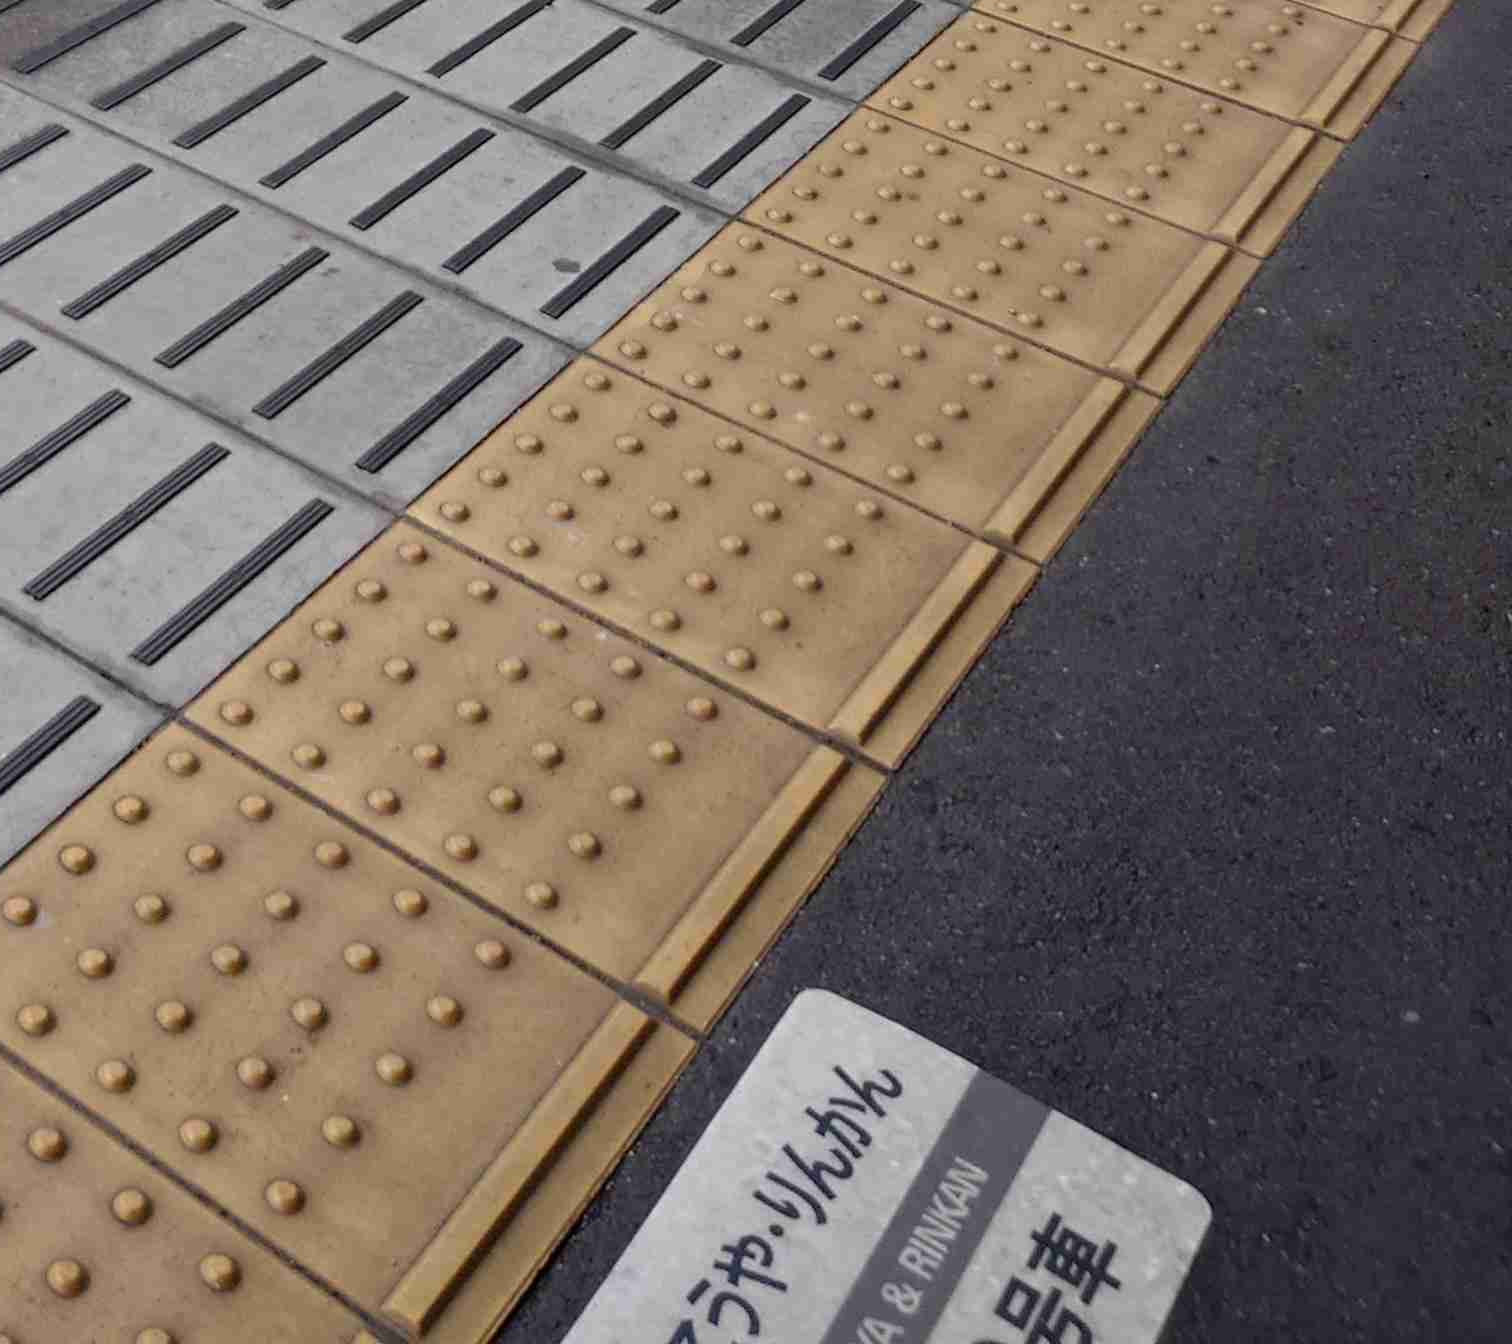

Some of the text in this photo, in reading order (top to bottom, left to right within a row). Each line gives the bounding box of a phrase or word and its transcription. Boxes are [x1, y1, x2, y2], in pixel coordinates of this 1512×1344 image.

[897, 1155, 991, 1281] RINKAN
[972, 1211, 1122, 1344] 号車
[880, 1281, 925, 1315] &
